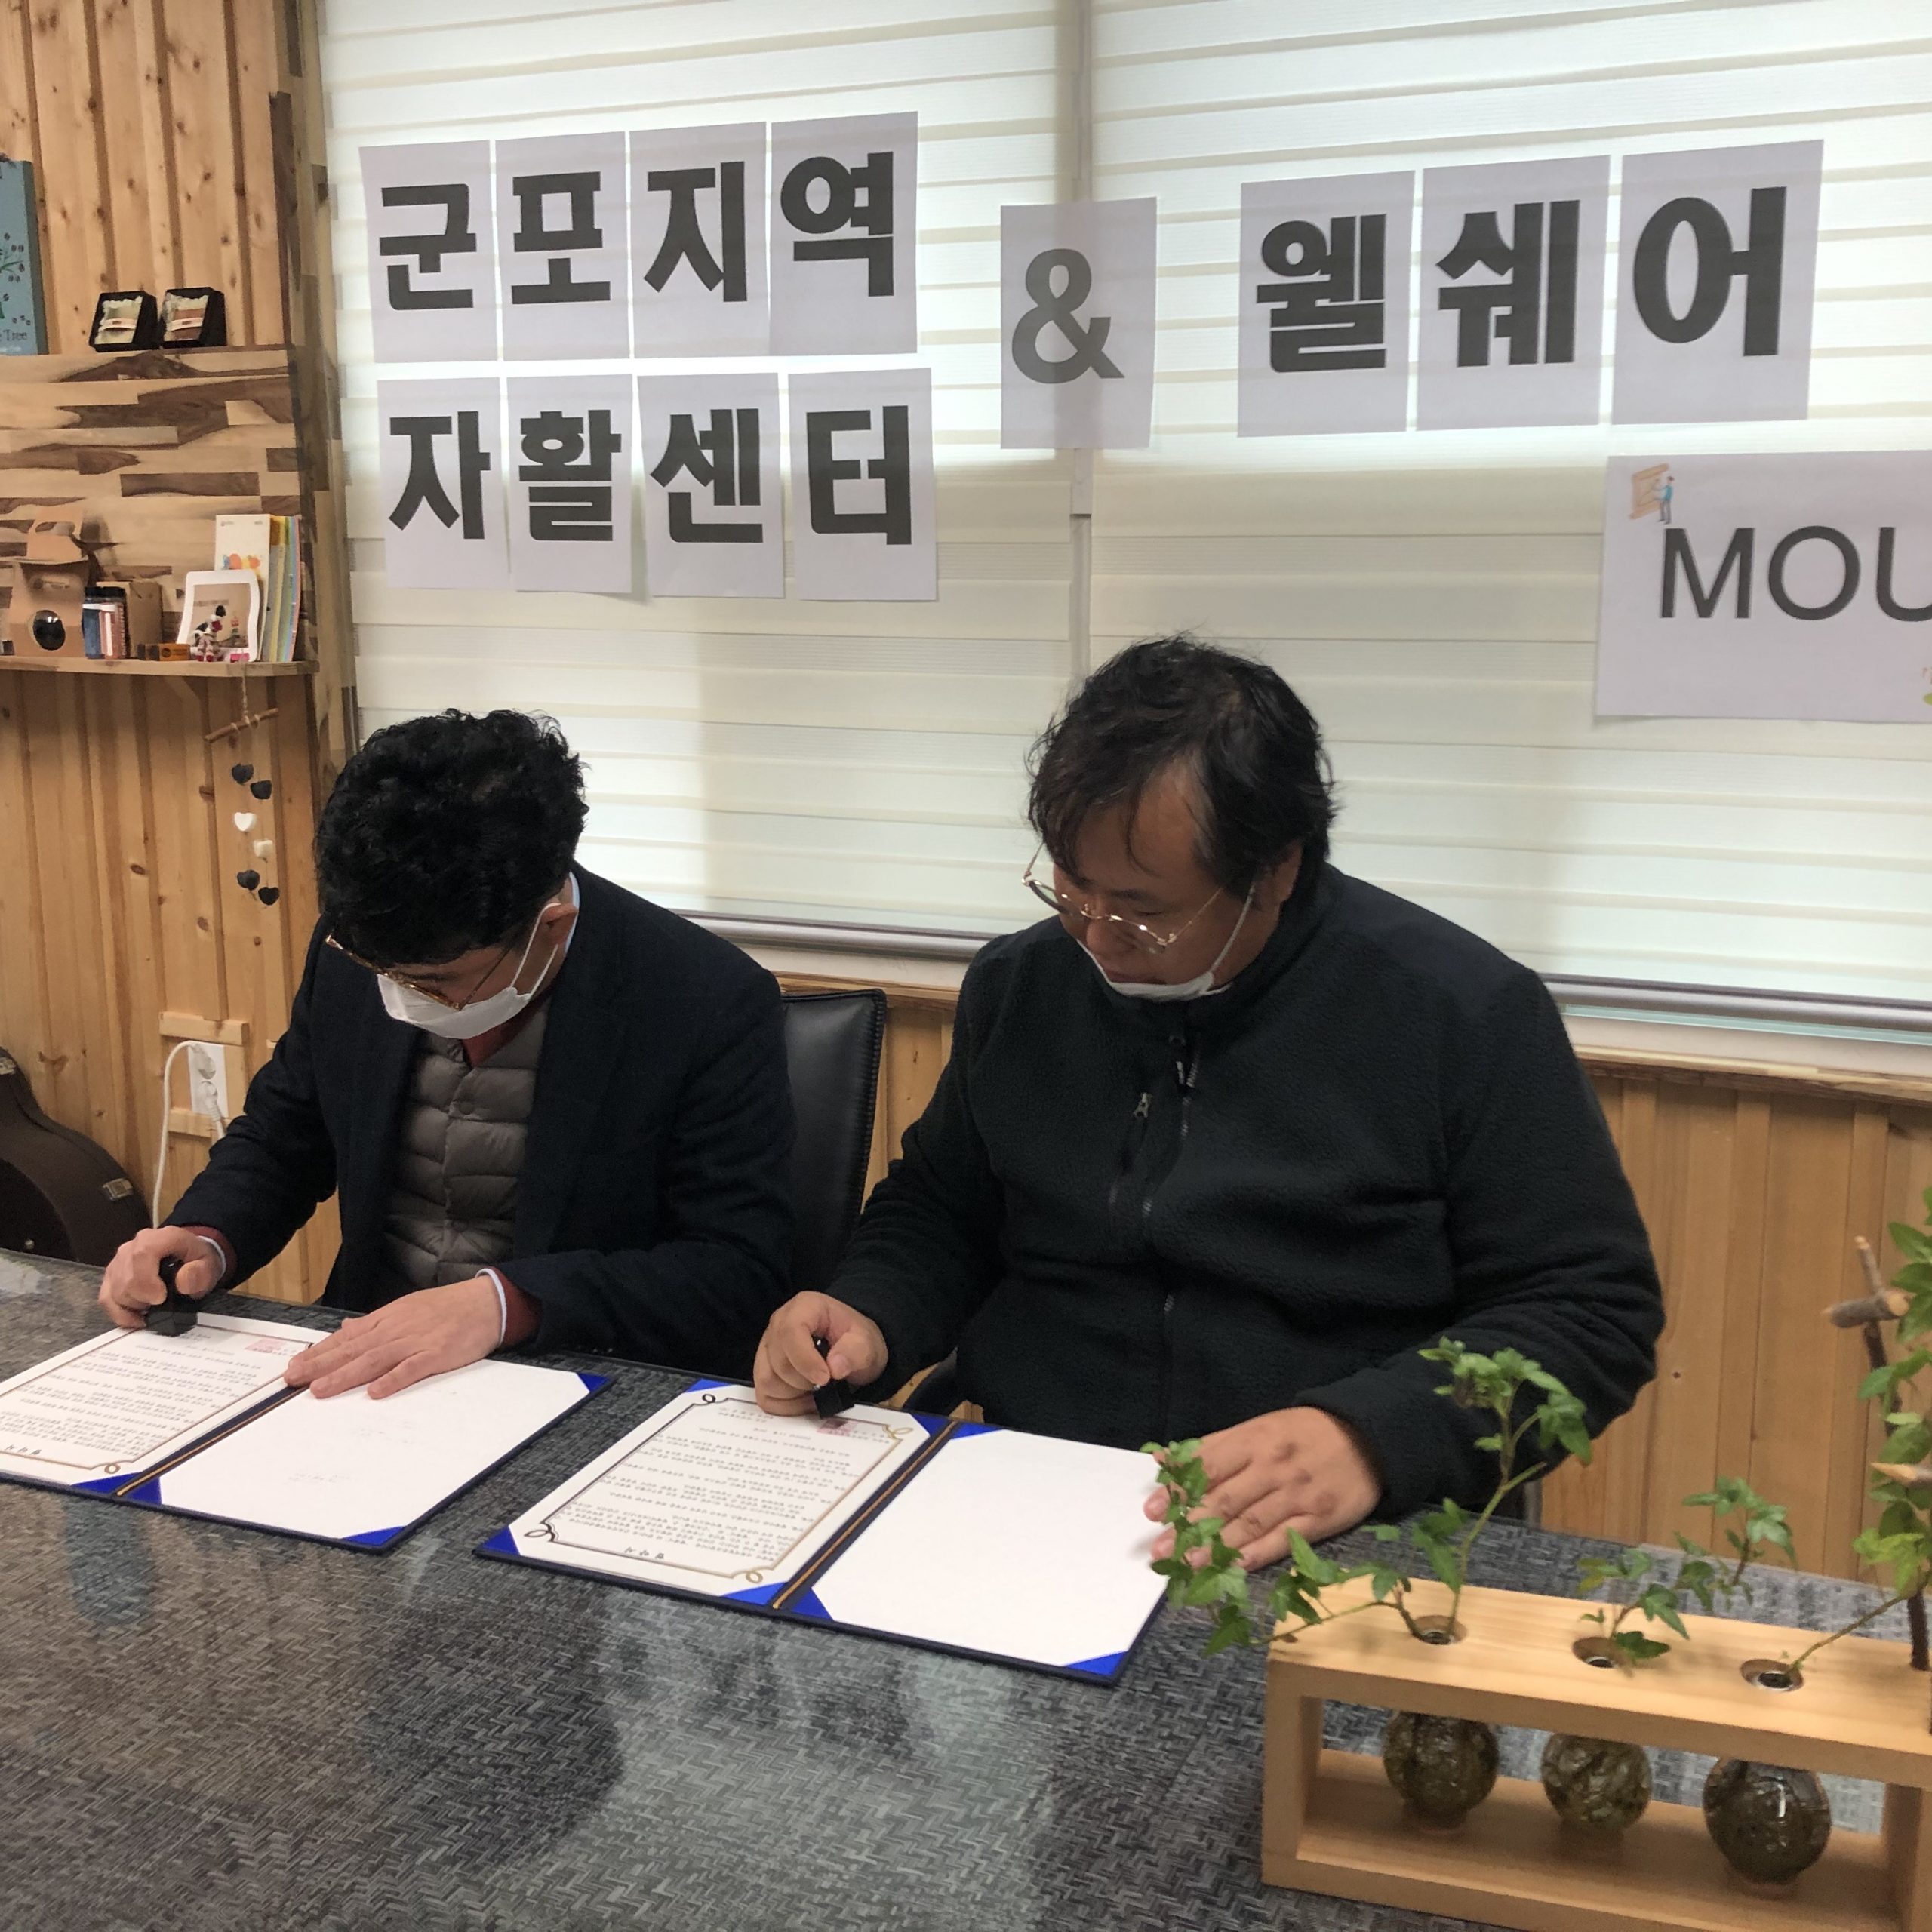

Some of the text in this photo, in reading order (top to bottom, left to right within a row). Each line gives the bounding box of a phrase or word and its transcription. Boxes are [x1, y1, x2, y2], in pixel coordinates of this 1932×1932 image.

[379, 151, 895, 311] 군포지역
[1011, 186, 1788, 384] & 웰쉐어
[388, 405, 912, 546] 자활센터
[1659, 525, 1932, 623] MOU
